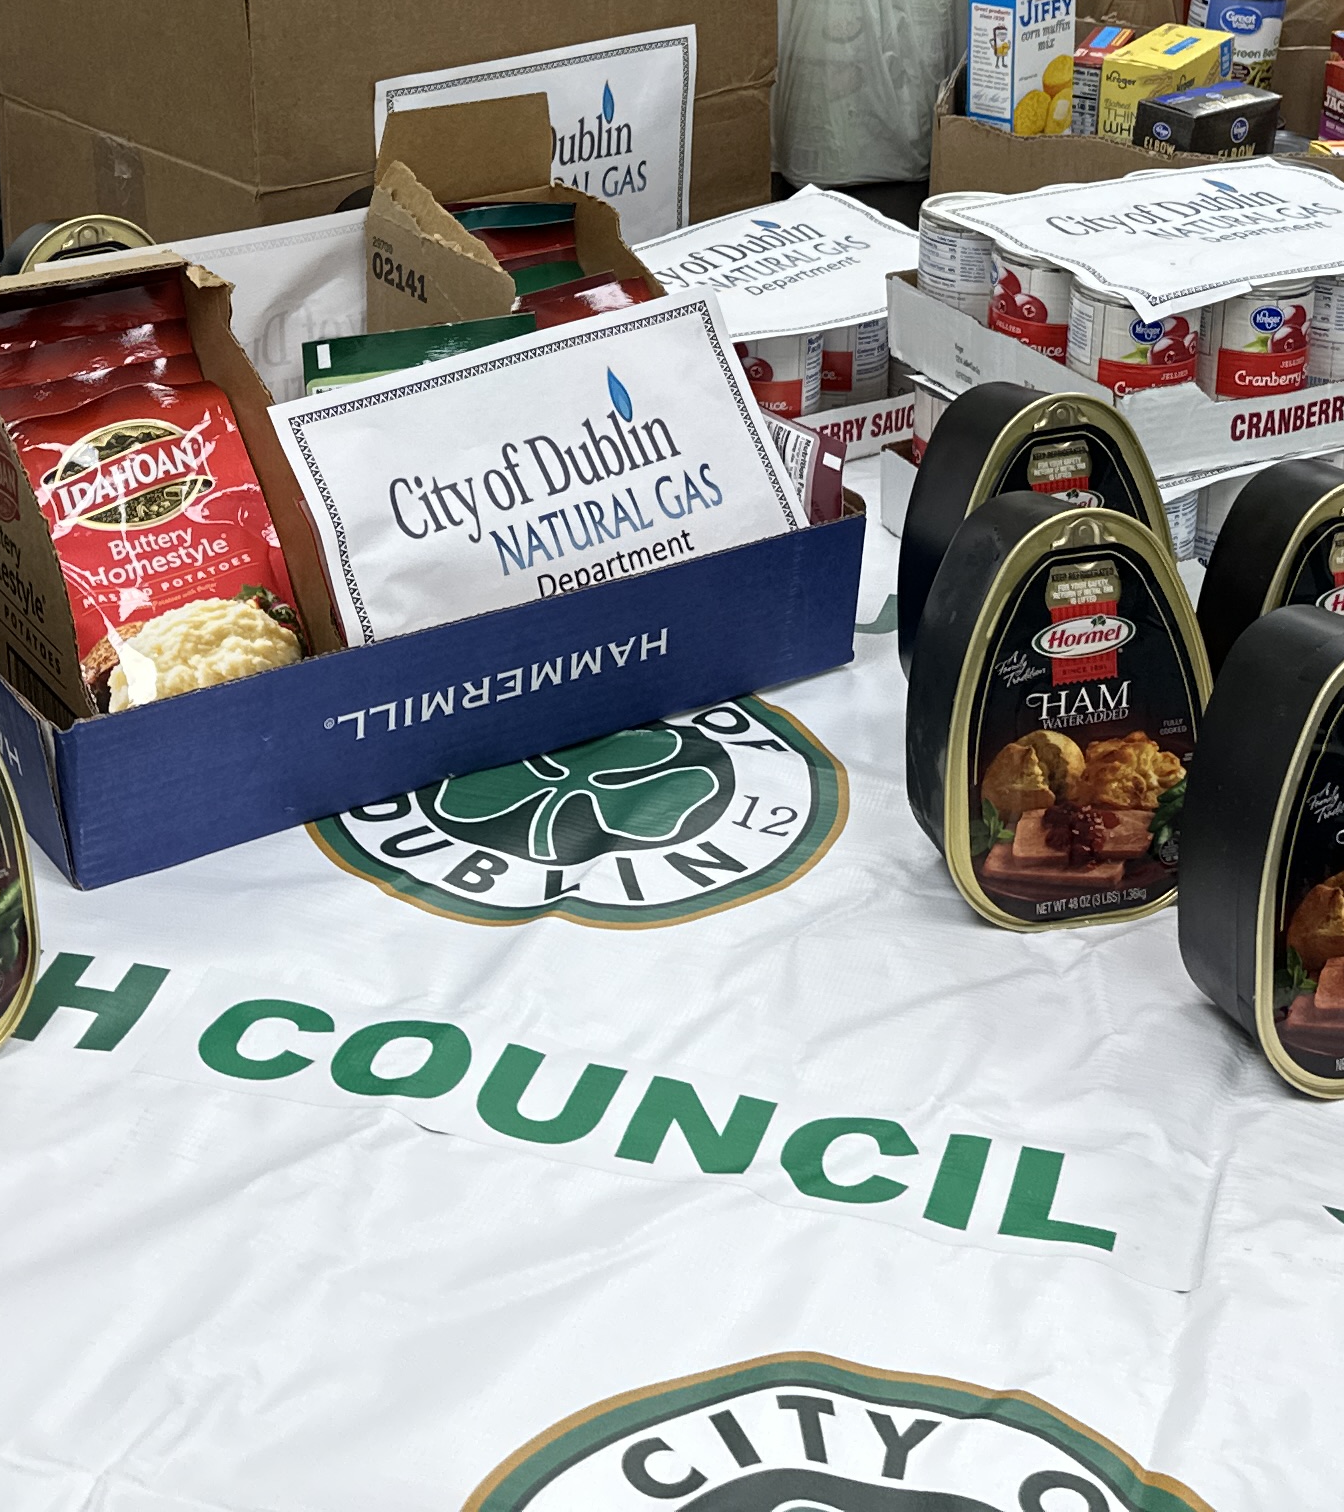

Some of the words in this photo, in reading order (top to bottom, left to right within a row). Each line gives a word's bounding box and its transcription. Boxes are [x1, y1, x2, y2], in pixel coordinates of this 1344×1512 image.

[1021, 29, 1045, 42] corn
[1046, 21, 1071, 38] muffin
[1226, 11, 1256, 25] Great
[1038, 38, 1054, 52] mix
[1107, 71, 1137, 89] Kroger
[1143, 137, 1175, 155] ELBOW
[600, 160, 648, 198] GAS
[1046, 214, 1137, 236] City
[1125, 204, 1168, 225] of
[1156, 188, 1291, 219] Dublin
[1142, 212, 1282, 240] NATURAL
[1277, 202, 1343, 220] GAS
[1202, 220, 1333, 243] Department
[372, 252, 428, 304] 02141
[695, 249, 822, 292] NATURAL
[814, 235, 871, 256] GAS
[745, 256, 861, 296] Department
[1134, 322, 1161, 338] Kroger
[1256, 312, 1282, 326] Kroger
[1161, 370, 1189, 381] JELLIED
[1235, 372, 1302, 387] Cranberry
[58, 440, 200, 517] IDAHOAN
[389, 475, 483, 544] City
[483, 442, 534, 511] of
[524, 410, 681, 497] Dublin
[490, 487, 654, 576] NATURAL
[655, 463, 722, 520] GAS
[87, 535, 228, 587] Homestyle
[107, 527, 193, 560] Buttery
[537, 530, 695, 598] Department
[5, 609, 61, 674] POTATOES
[1047, 624, 1122, 648] Hormel
[337, 626, 668, 741] HAMMERMILL
[1025, 680, 1132, 721] HAM
[1042, 714, 1087, 729] WATER
[1086, 708, 1129, 724] ADDED
[730, 794, 799, 838] 12
[349, 794, 748, 902] DUBLIN
[196, 997, 1120, 1253] COUNCIL
[619, 1393, 944, 1503] CITY
